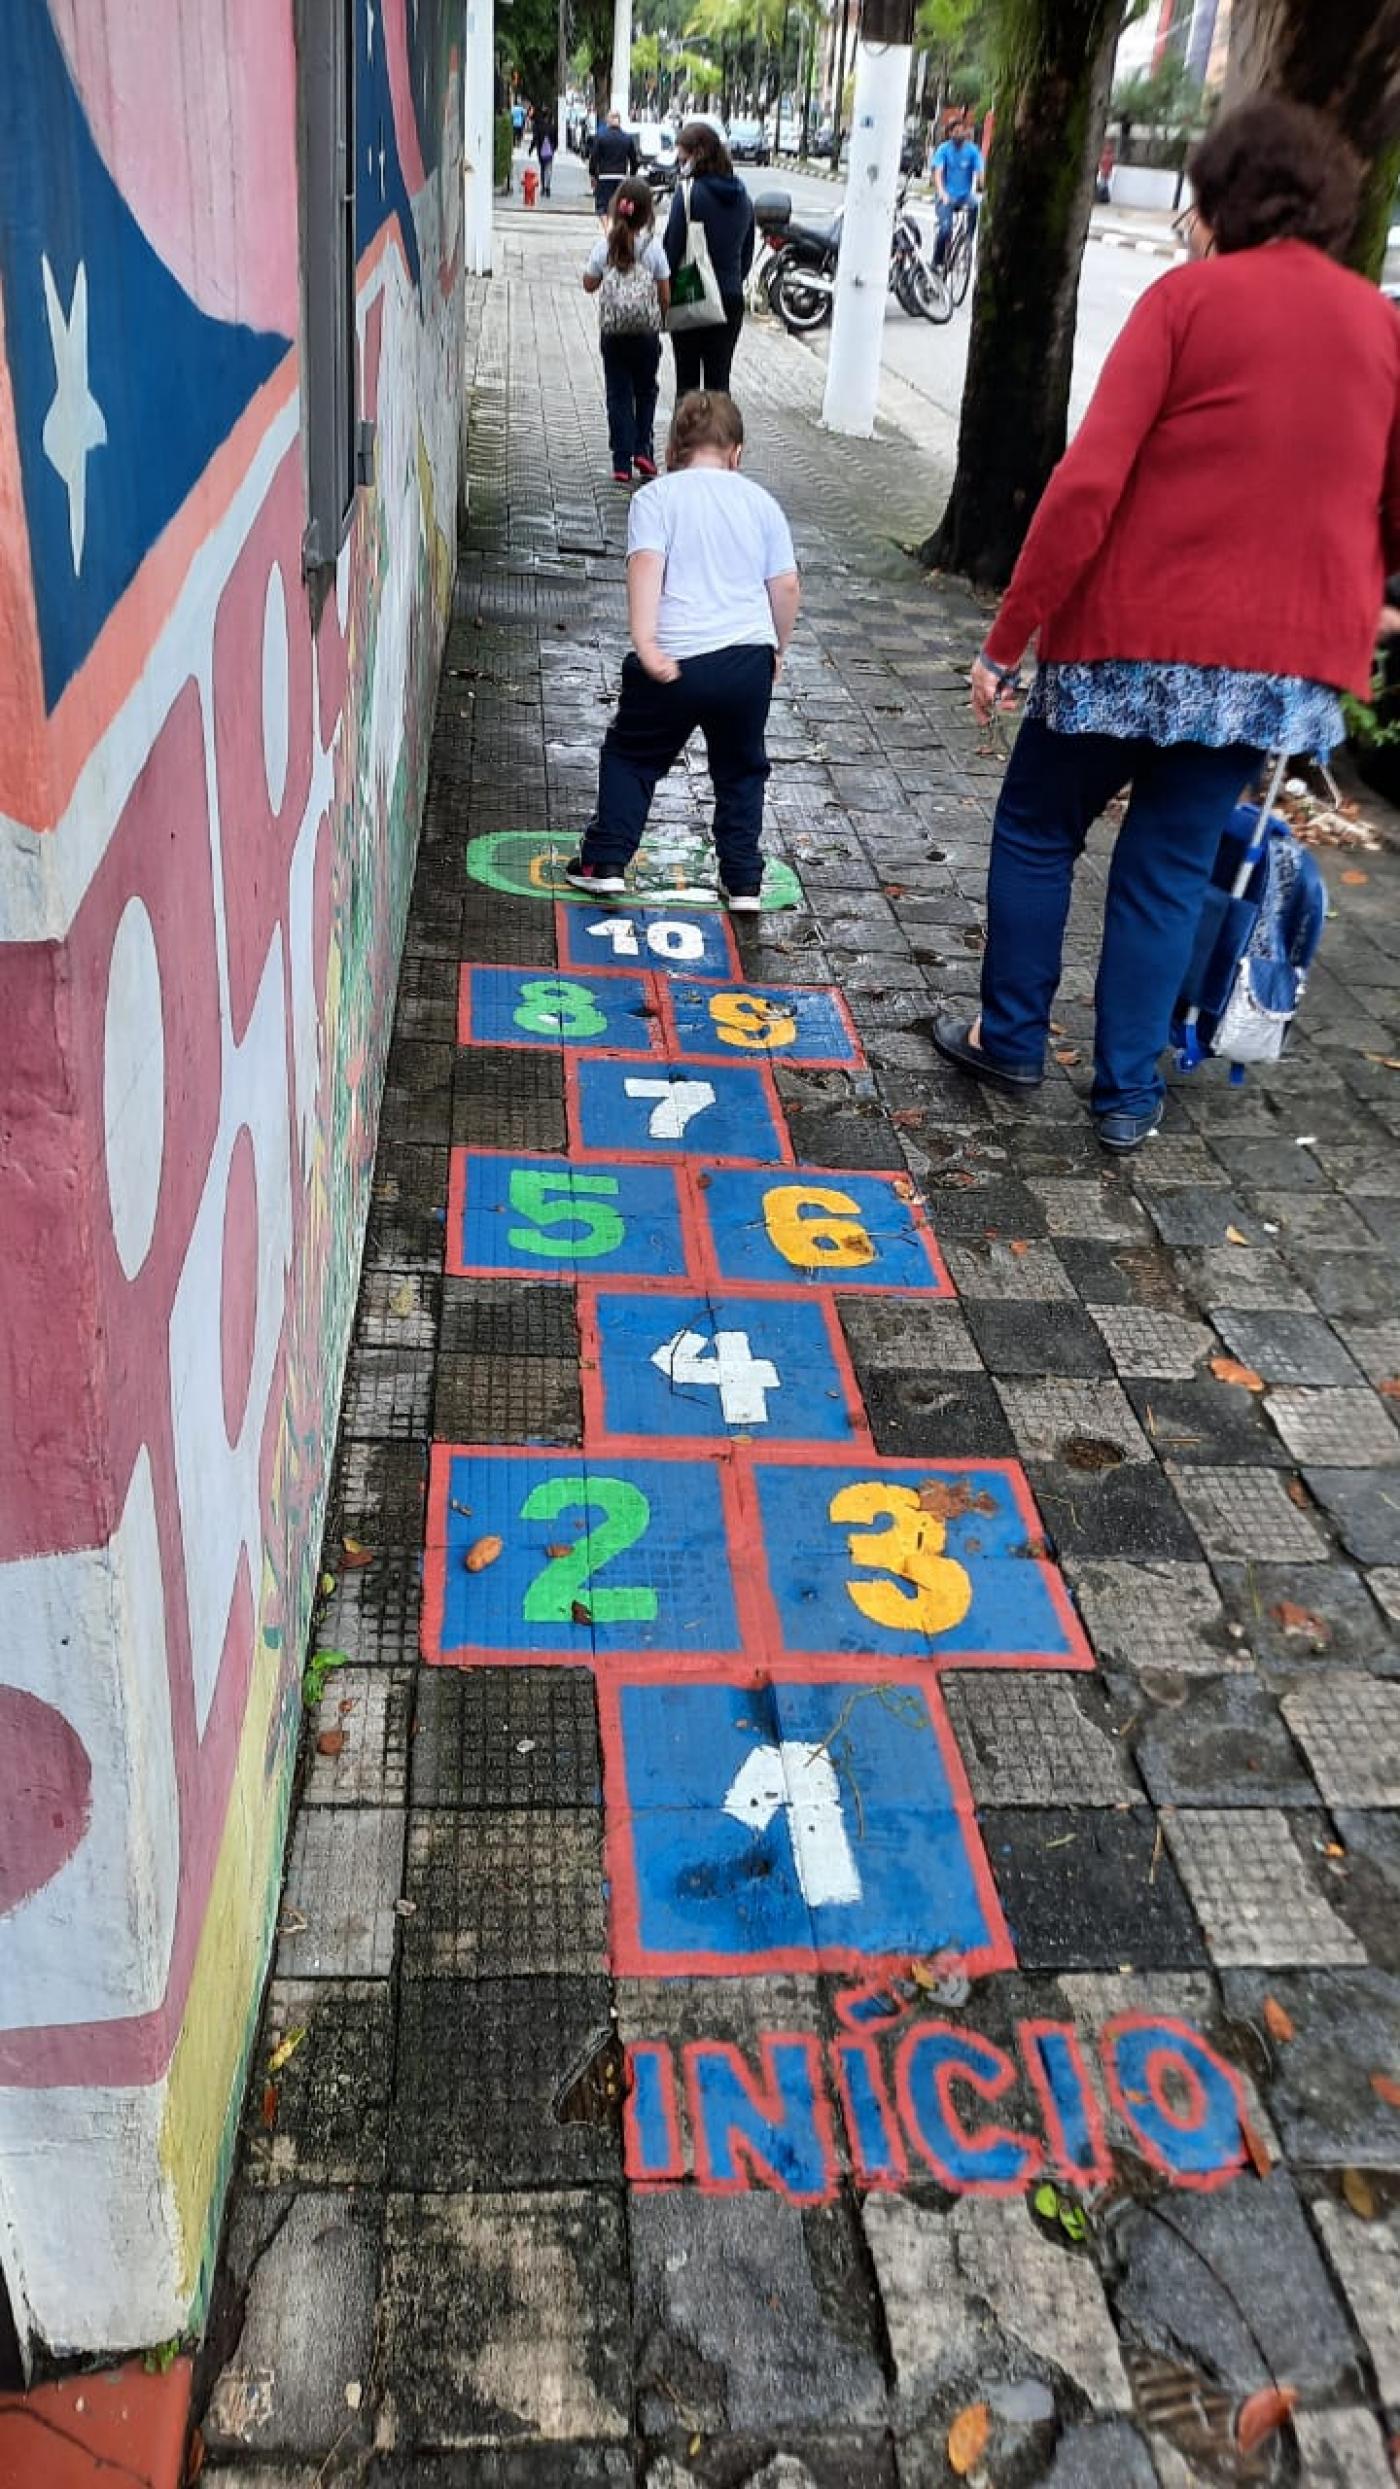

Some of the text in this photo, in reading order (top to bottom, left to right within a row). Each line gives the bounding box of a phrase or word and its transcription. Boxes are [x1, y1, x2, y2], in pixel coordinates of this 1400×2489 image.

[584, 919, 705, 960] 10
[513, 980, 608, 1038] 8
[623, 1078, 717, 1139] 7
[507, 1169, 626, 1257] 5
[762, 1185, 876, 1268] 6
[650, 1328, 782, 1424] 4
[519, 1477, 659, 1623] 2
[829, 1481, 973, 1635] 3
[720, 1741, 864, 1908] 1
[623, 1982, 1252, 2207] INÍCIO
